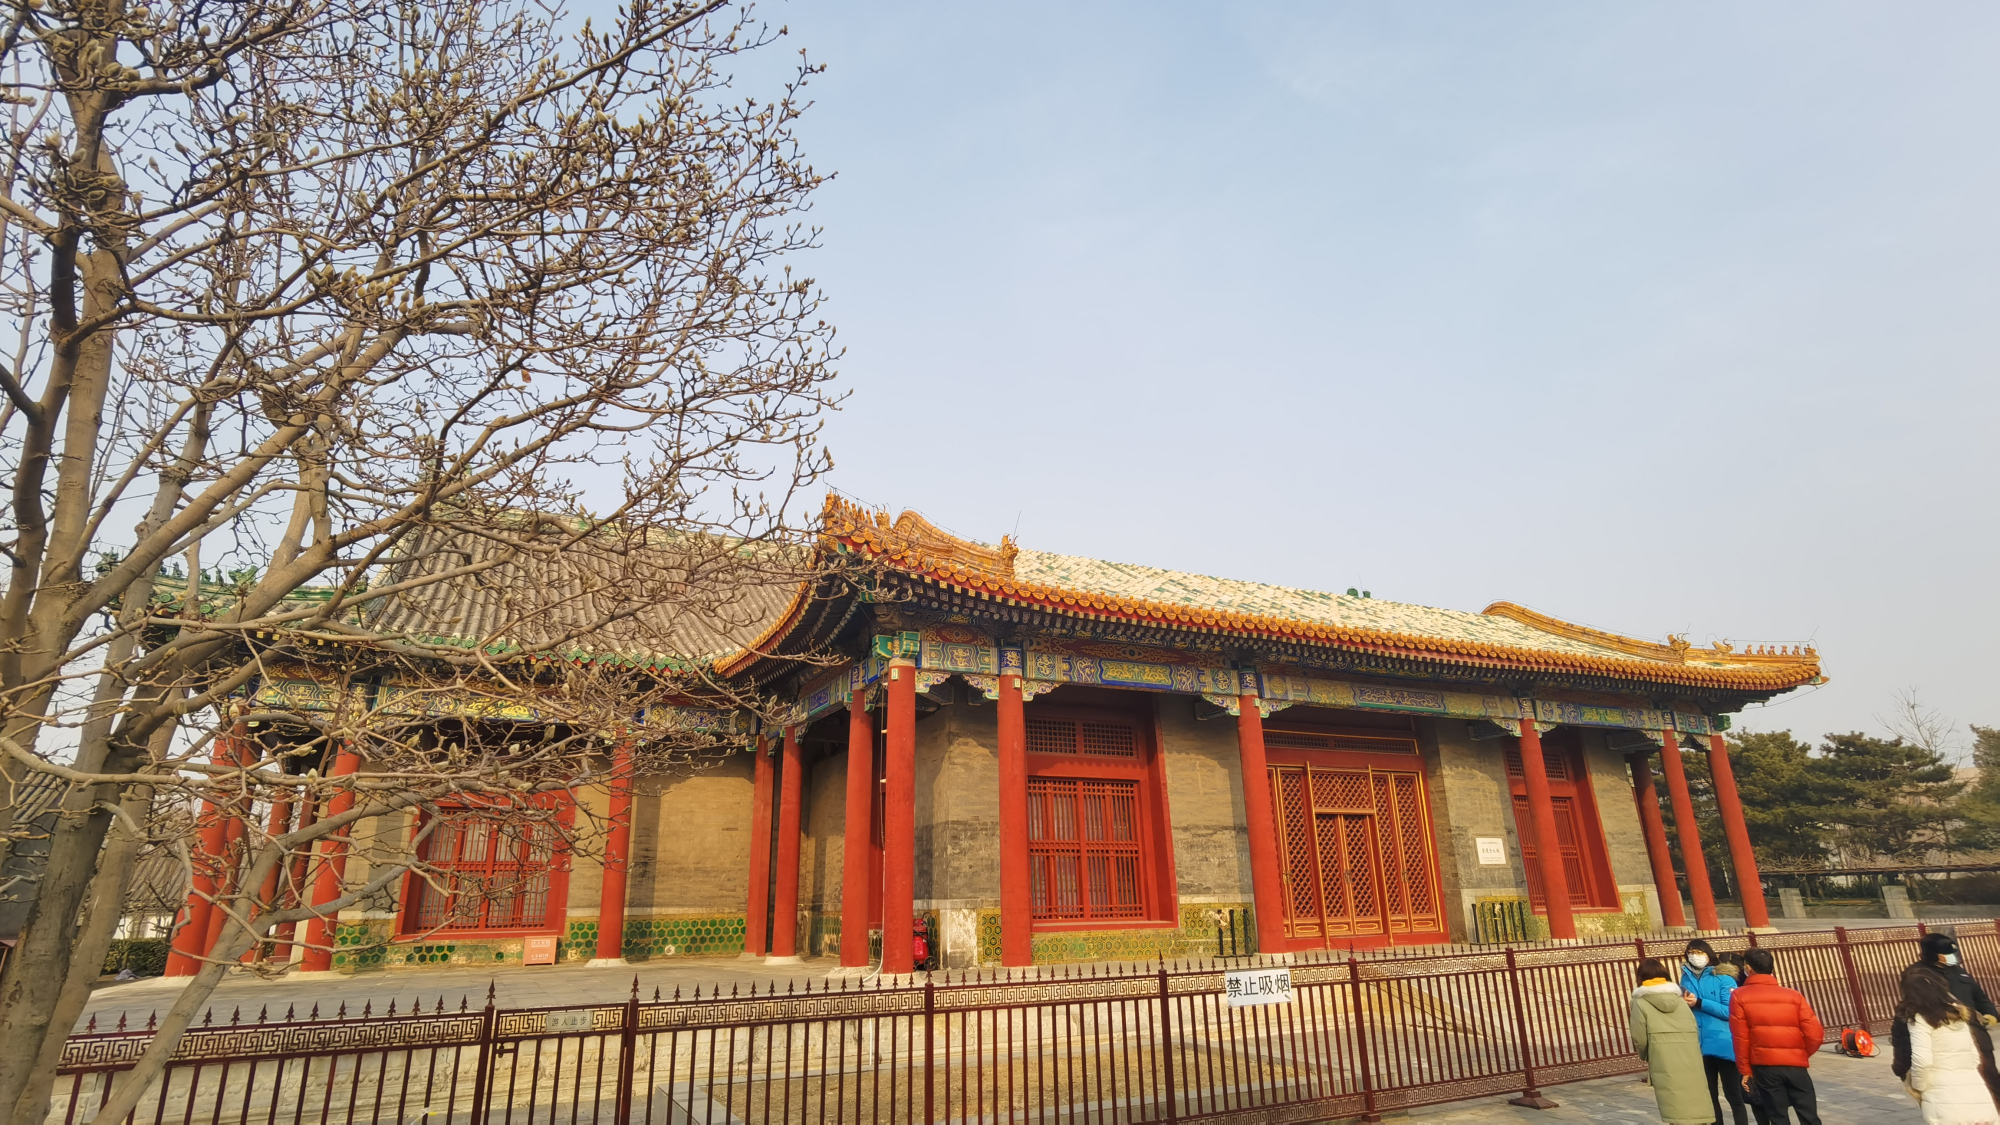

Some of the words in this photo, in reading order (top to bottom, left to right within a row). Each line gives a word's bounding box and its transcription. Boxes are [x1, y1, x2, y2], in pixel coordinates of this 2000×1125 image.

[1227, 974, 1290, 998] 禁止吸烟
[551, 1016, 588, 1027] 游人止步
